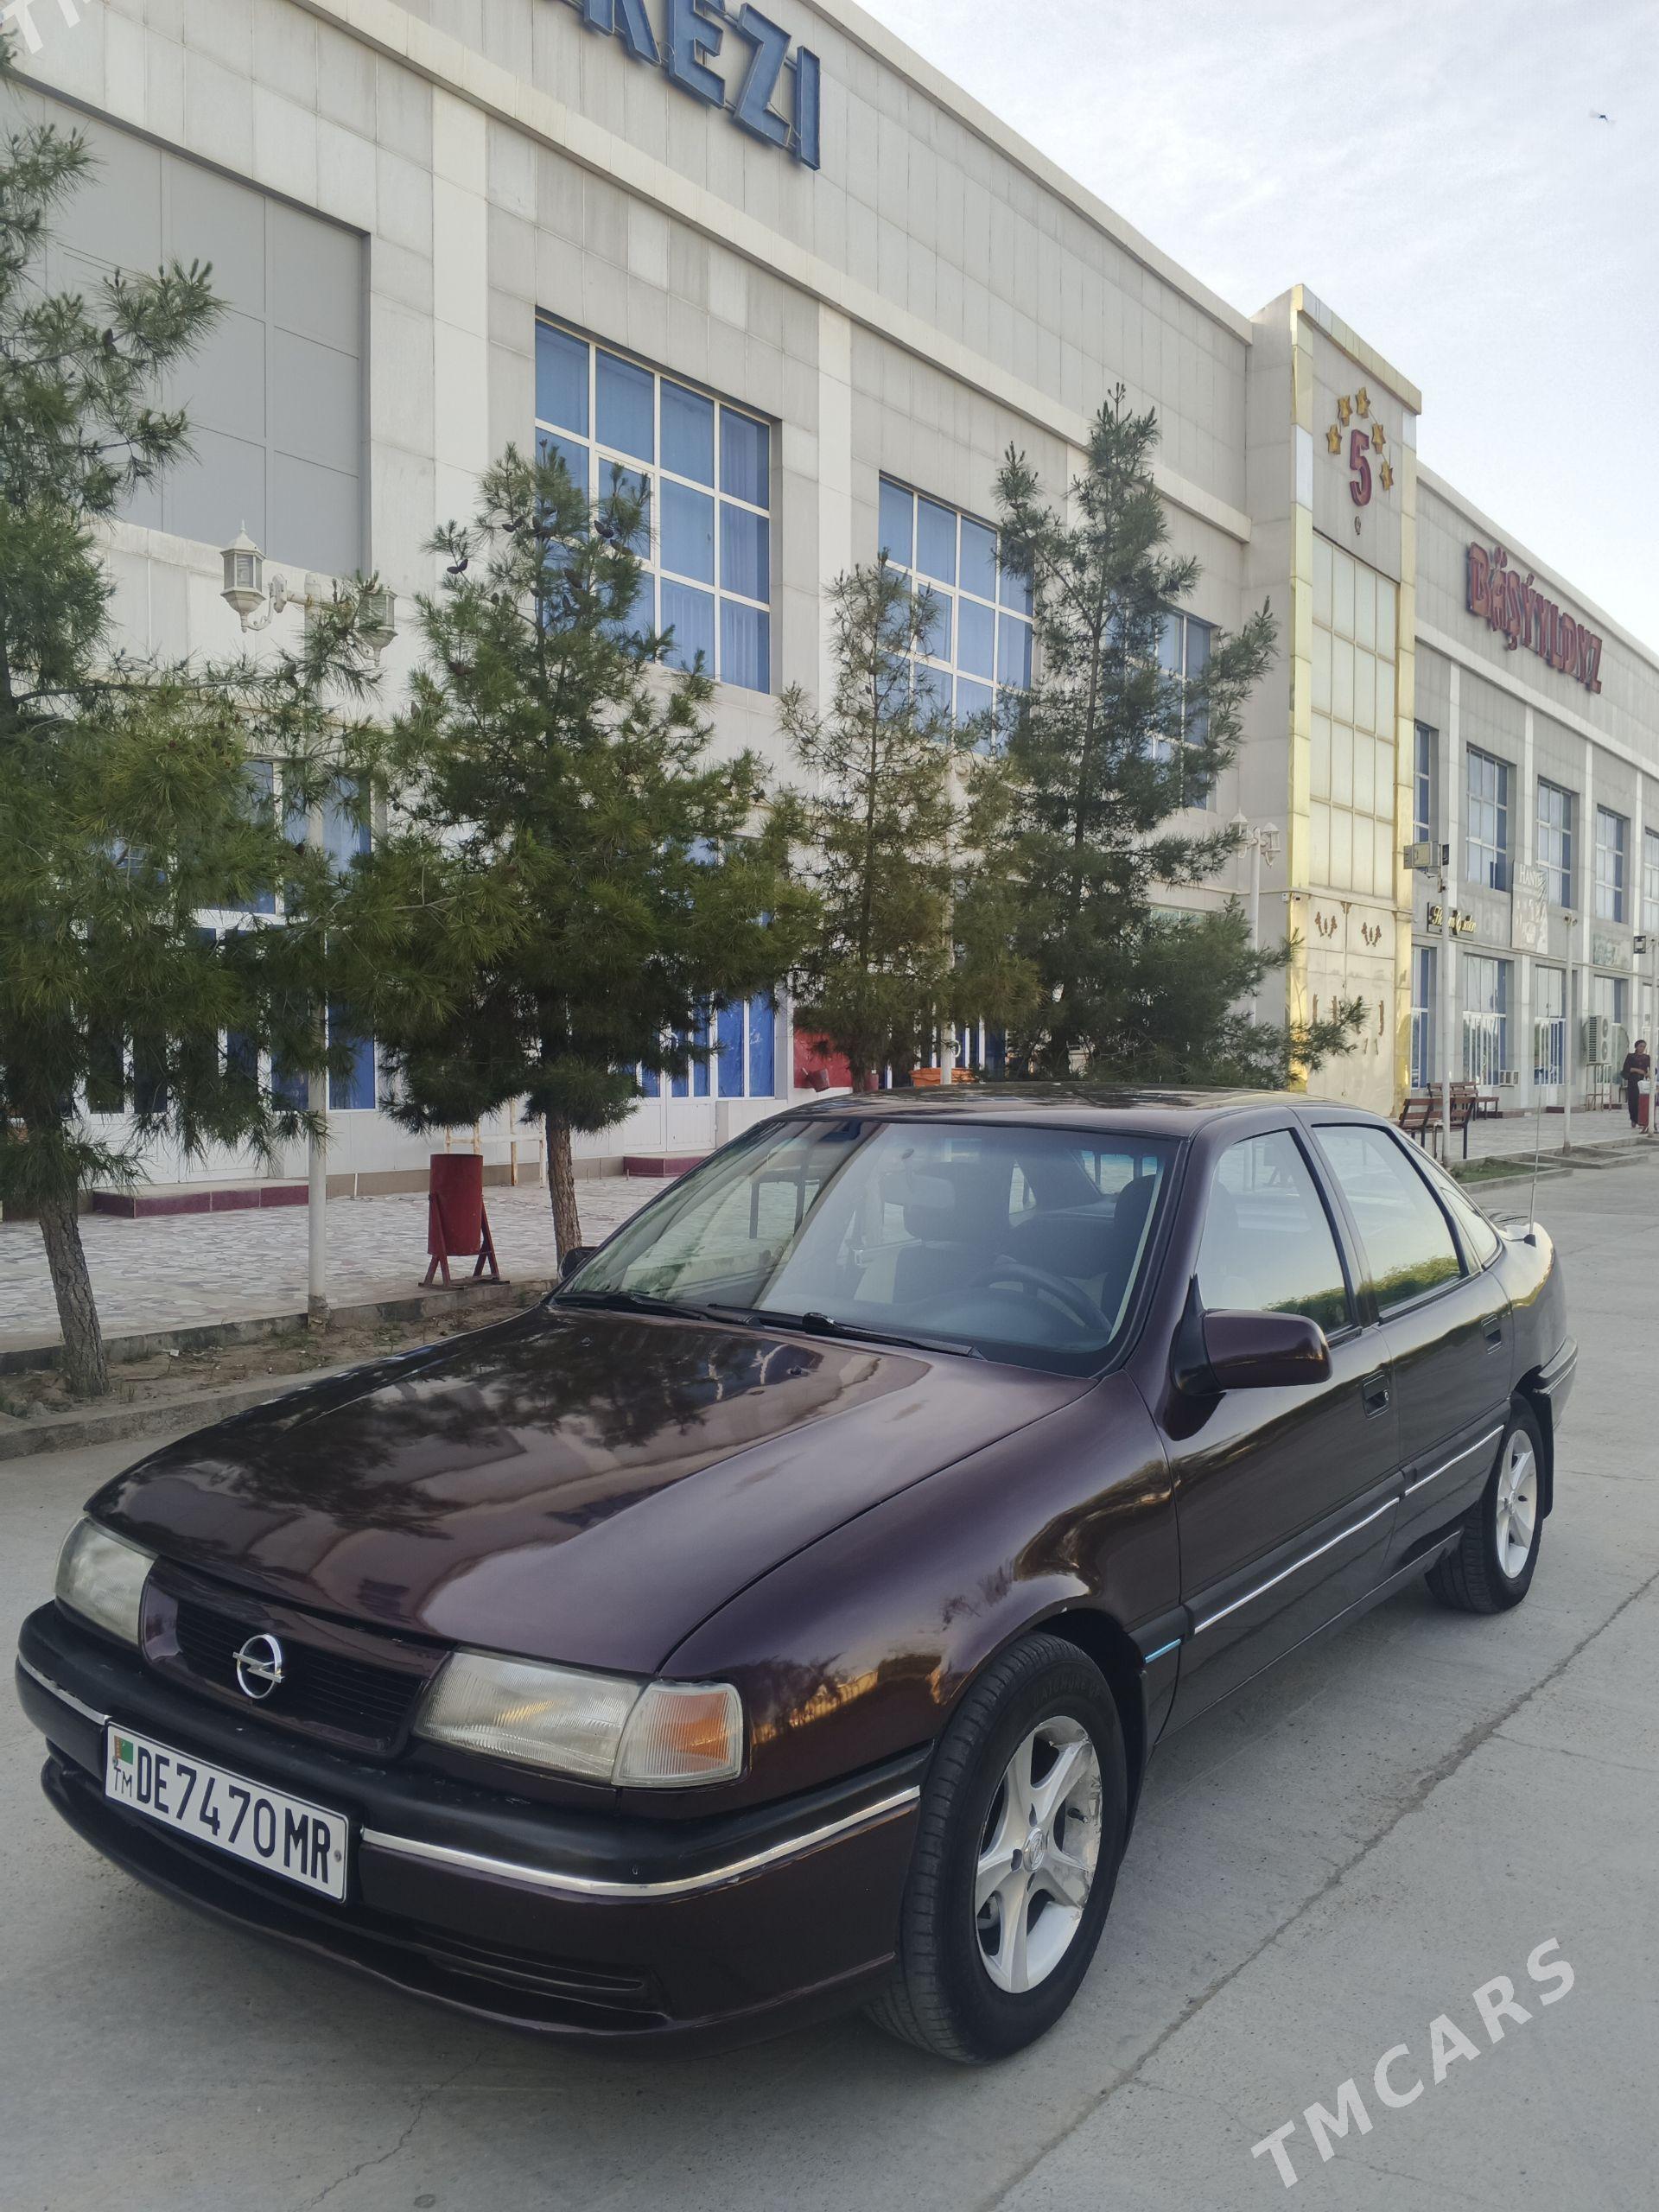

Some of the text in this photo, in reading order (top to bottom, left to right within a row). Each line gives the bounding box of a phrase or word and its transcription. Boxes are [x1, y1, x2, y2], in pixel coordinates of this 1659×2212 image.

[1350, 429, 1372, 506] 5
[113, 1767, 132, 1798] TM
[137, 1745, 331, 1884] DE7470MR
